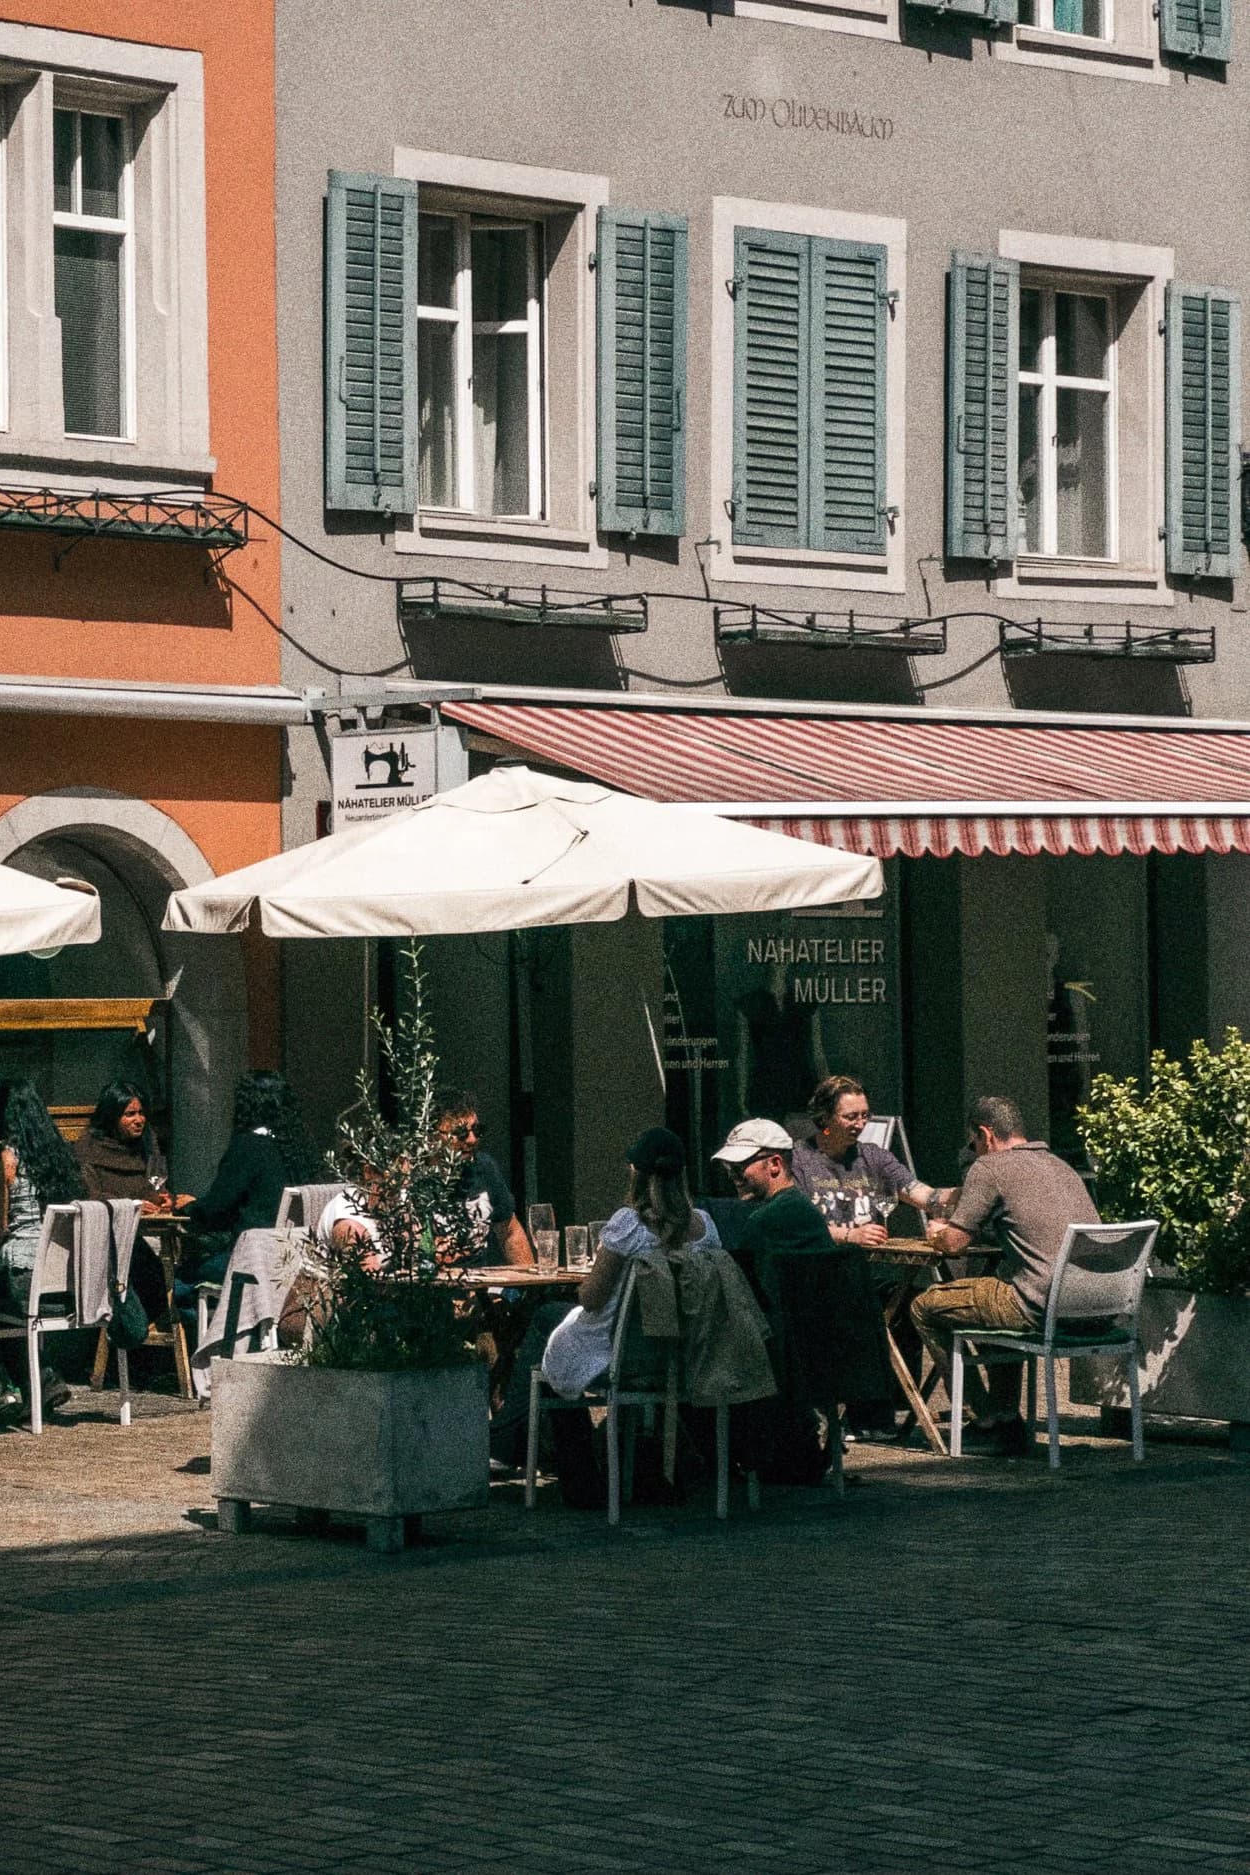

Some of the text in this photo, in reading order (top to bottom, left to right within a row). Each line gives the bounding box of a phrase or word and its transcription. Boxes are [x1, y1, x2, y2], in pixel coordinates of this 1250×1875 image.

[338, 797, 395, 809] NÄHATELIER
[748, 934, 885, 963] NÄHATELIER
[795, 972, 886, 1003] MÜLLER
